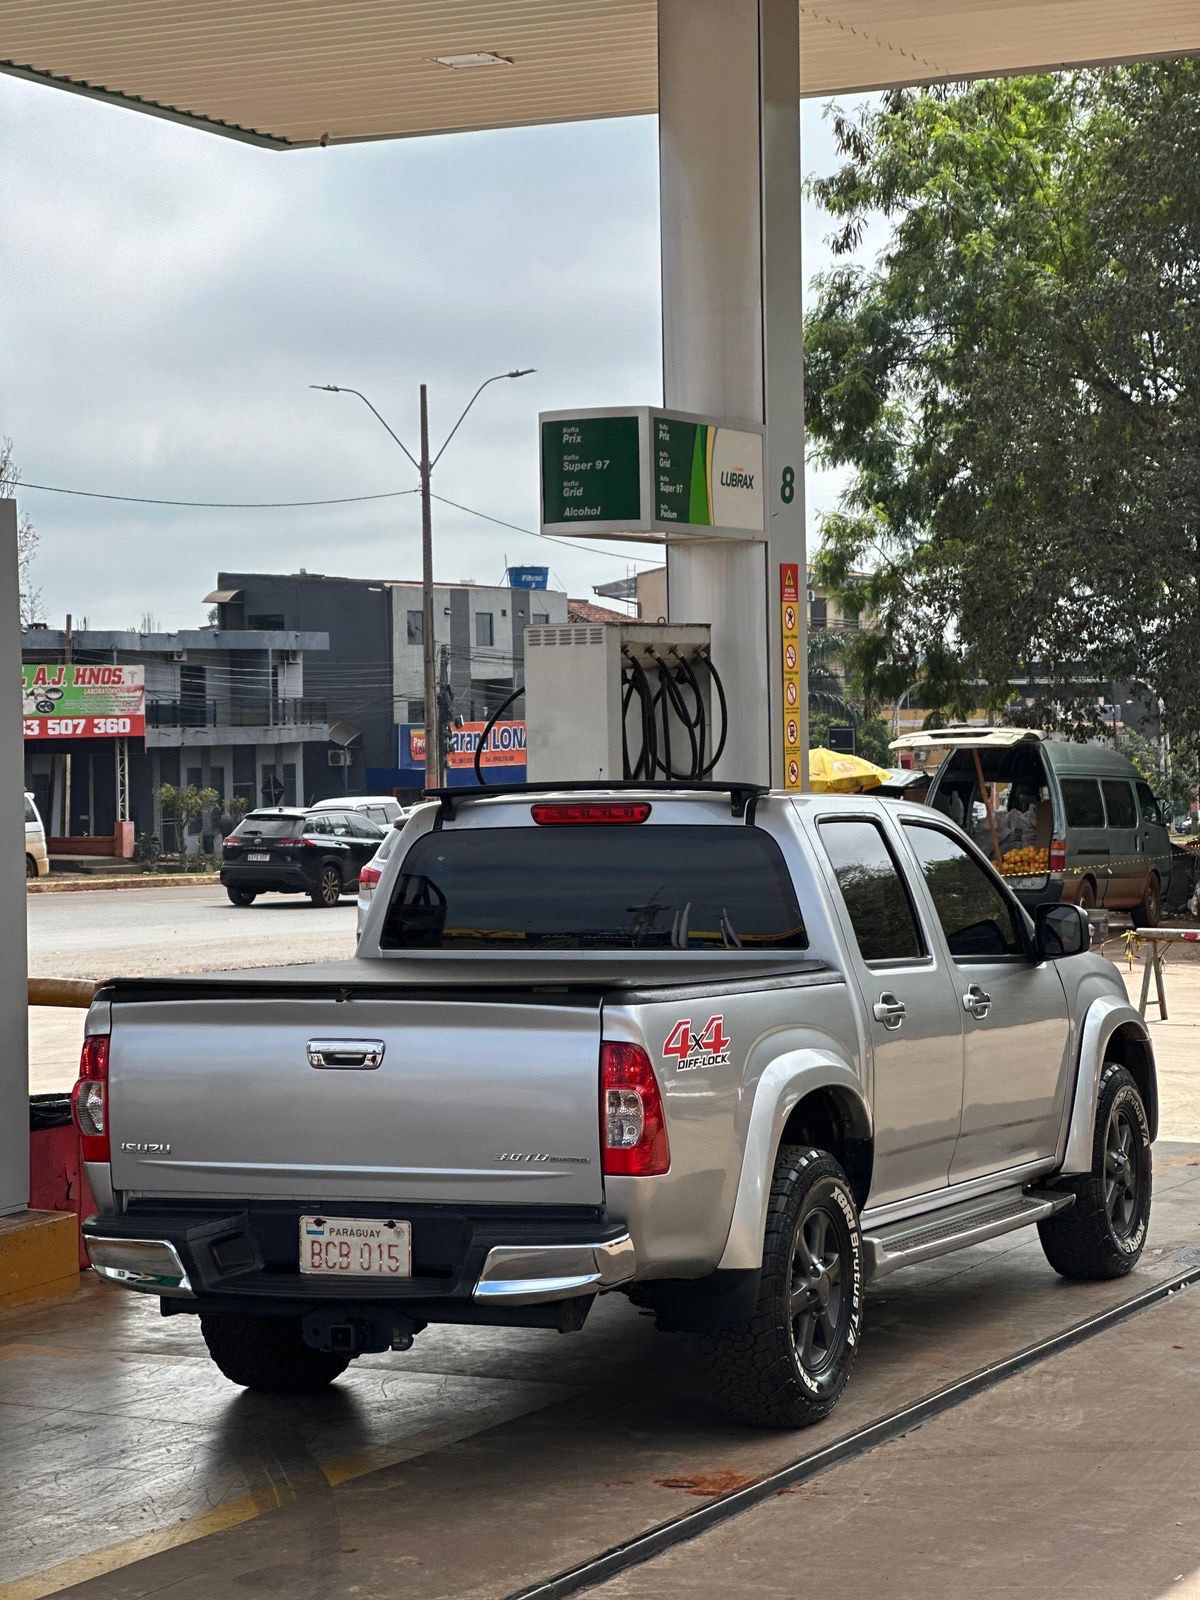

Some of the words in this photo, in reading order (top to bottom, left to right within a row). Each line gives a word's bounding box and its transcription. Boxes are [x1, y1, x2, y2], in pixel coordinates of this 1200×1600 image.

[563, 434, 582, 444] Prix
[659, 431, 670, 441] Prix
[563, 462, 592, 472] Super
[595, 460, 610, 470] 97
[660, 458, 671, 469] Grid
[660, 482, 675, 494] Super
[676, 484, 683, 495] 97
[721, 471, 754, 489] LUBRAX
[781, 466, 795, 504] 8
[563, 488, 583, 497] Grid
[564, 507, 601, 517] Alcohol
[660, 509, 678, 519] Podium
[33, 667, 67, 686] A.J.
[73, 667, 126, 686] HNOS.
[47, 719, 86, 735] 507
[93, 718, 131, 734] 360
[492, 726, 527, 751] LON
[662, 1015, 731, 1061] 4x4
[677, 1053, 731, 1072] DIFF-LOCK
[121, 1143, 171, 1154] ISUZU
[829, 1186, 856, 1230] XBRI
[329, 1227, 381, 1238] PARAGUAY
[311, 1240, 351, 1270] BCB
[360, 1242, 400, 1273] 015
[850, 1232, 860, 1309] Brutus
[847, 1314, 859, 1347] T/A
